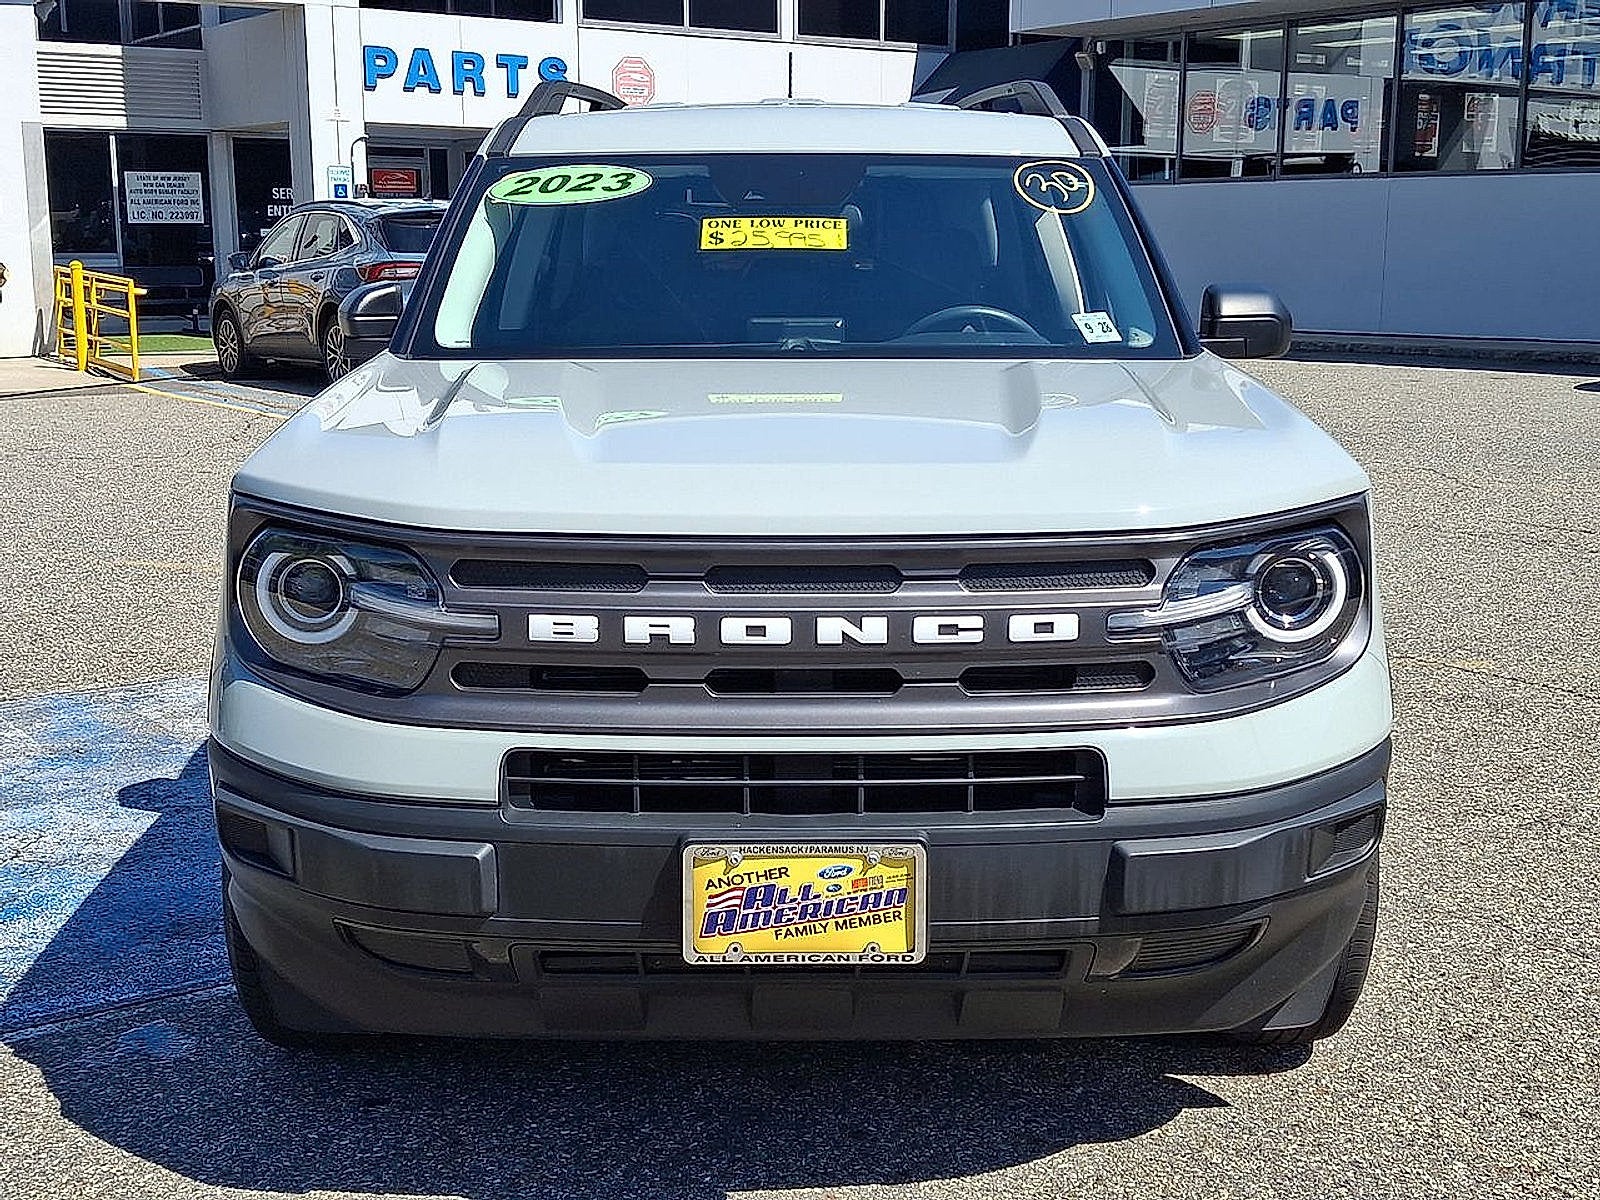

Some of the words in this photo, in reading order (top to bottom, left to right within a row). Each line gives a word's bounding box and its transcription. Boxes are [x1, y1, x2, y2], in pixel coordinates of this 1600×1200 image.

[363, 45, 567, 98] PARTS
[503, 173, 636, 197] 2023
[708, 219, 742, 229] ONE
[750, 219, 786, 228] LOW
[794, 219, 843, 229] PRICE
[708, 230, 725, 246] $
[527, 612, 1080, 645] BRONCO
[856, 845, 869, 854] NJ
[705, 866, 790, 890] ANOTHER
[774, 921, 830, 941] FAMILY
[834, 910, 904, 932] MEMBER
[694, 954, 734, 963] ALL
[739, 954, 851, 963] AMERICAN
[857, 954, 916, 963] FORD
